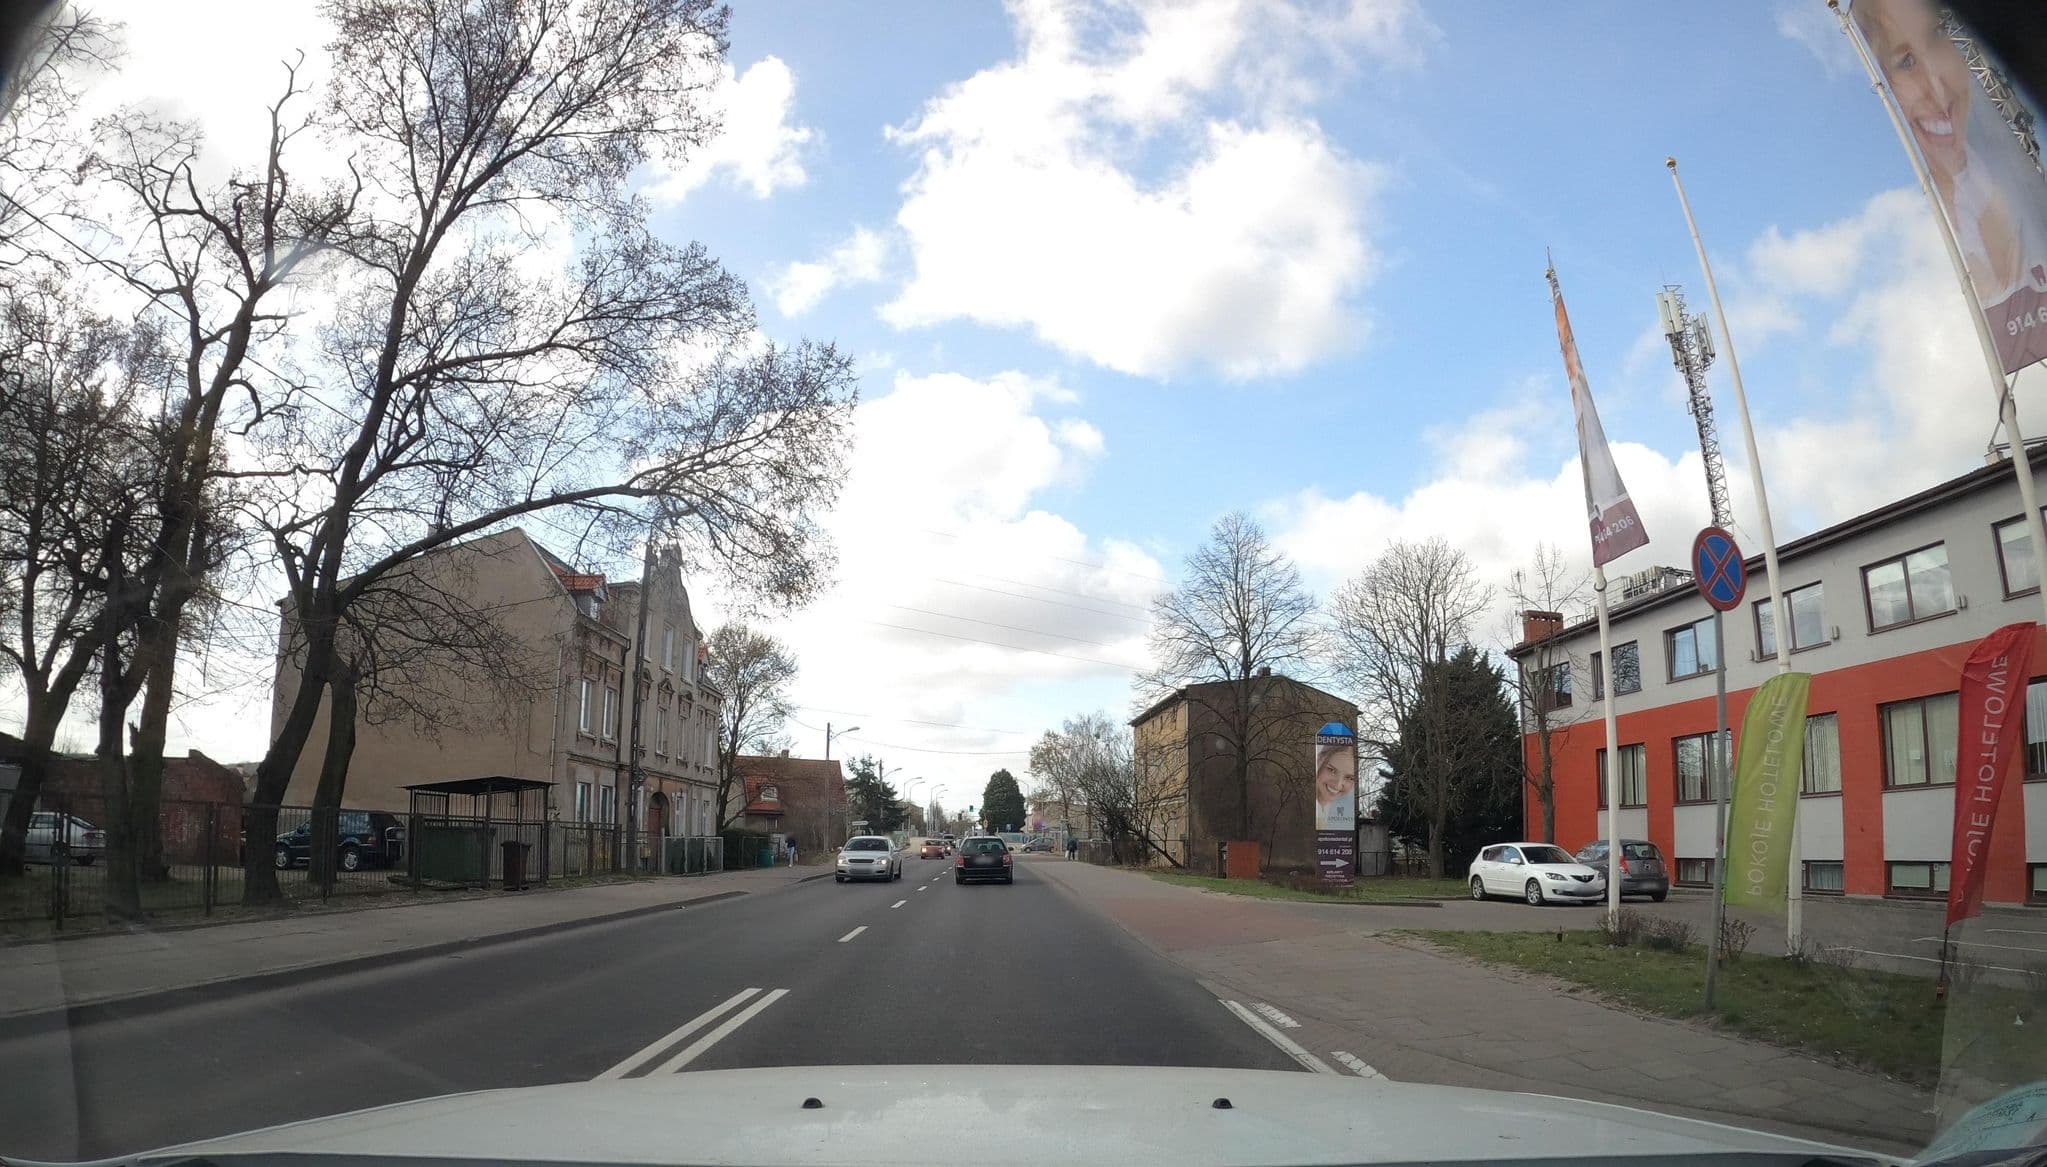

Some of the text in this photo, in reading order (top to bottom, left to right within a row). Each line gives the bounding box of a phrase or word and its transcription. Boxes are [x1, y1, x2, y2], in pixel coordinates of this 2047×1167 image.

[2006, 311, 2036, 336] 914
[1612, 515, 1634, 533] 206
[1317, 735, 1354, 745] DENTYSTA
